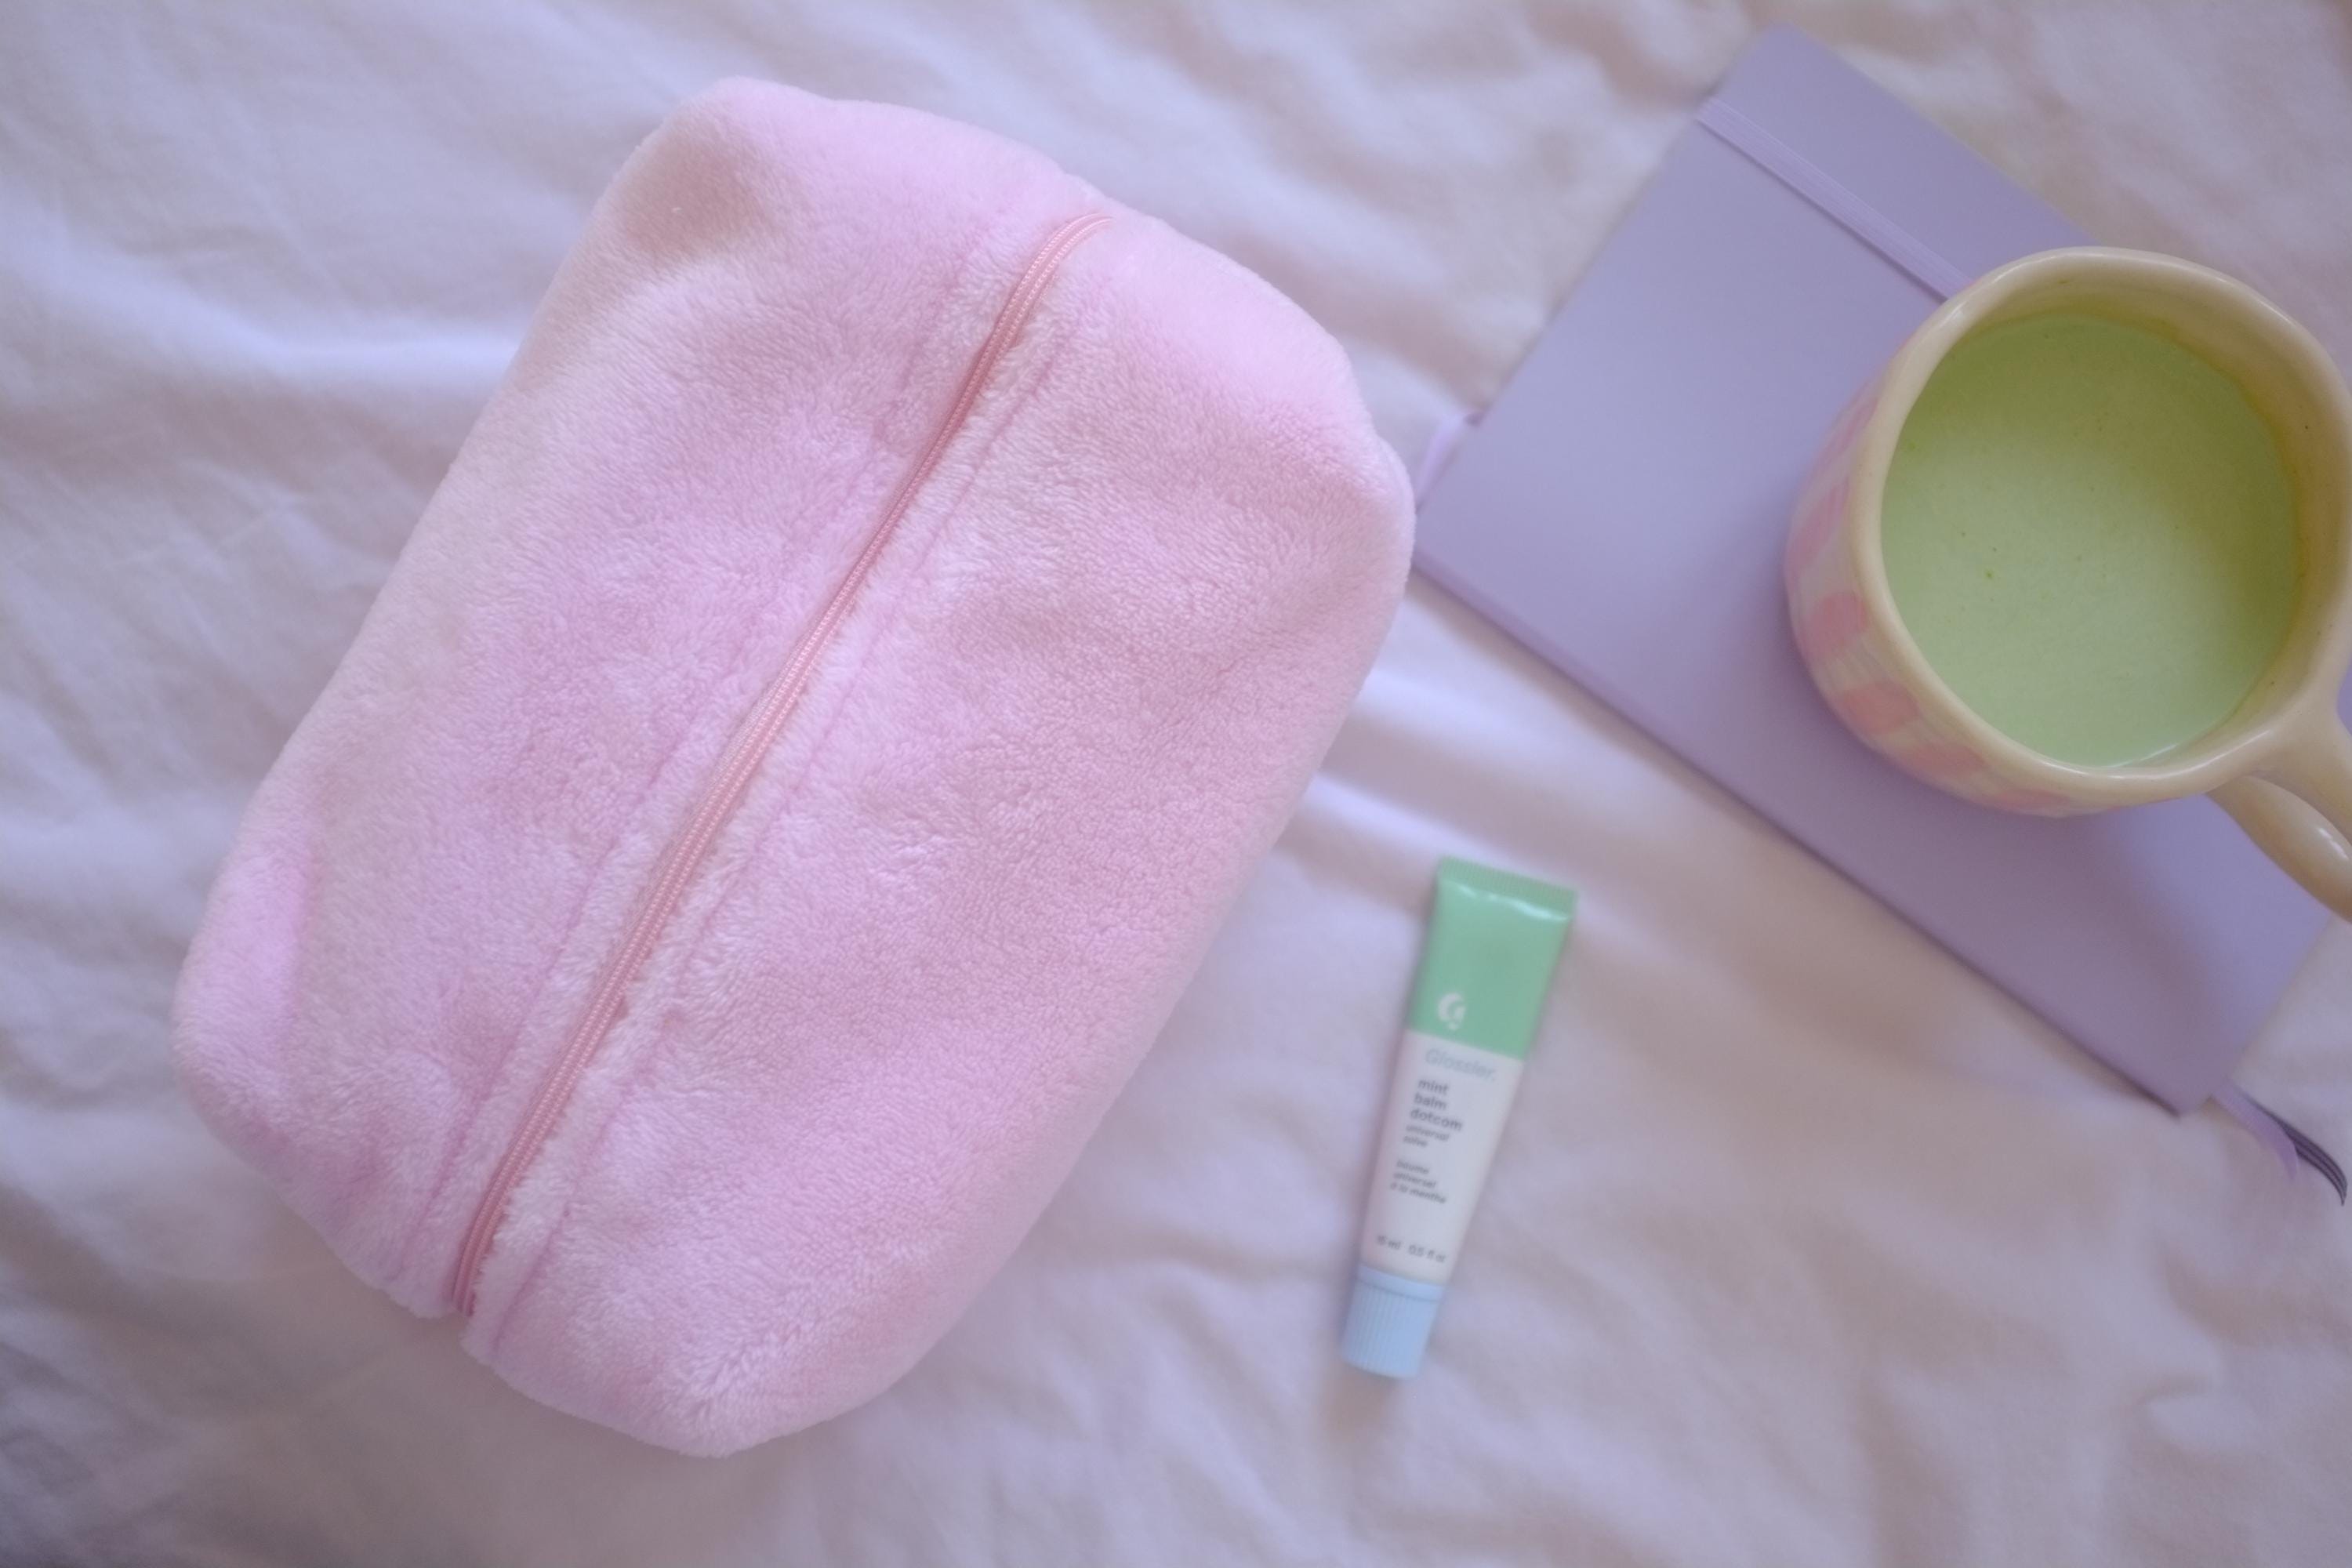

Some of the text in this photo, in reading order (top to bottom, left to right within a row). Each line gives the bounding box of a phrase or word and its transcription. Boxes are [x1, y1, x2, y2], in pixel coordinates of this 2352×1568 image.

[1417, 1079, 1449, 1095] mint
[1414, 1092, 1447, 1110] balm
[1410, 1108, 1463, 1131] dotcom
[1405, 1123, 1450, 1142] universal
